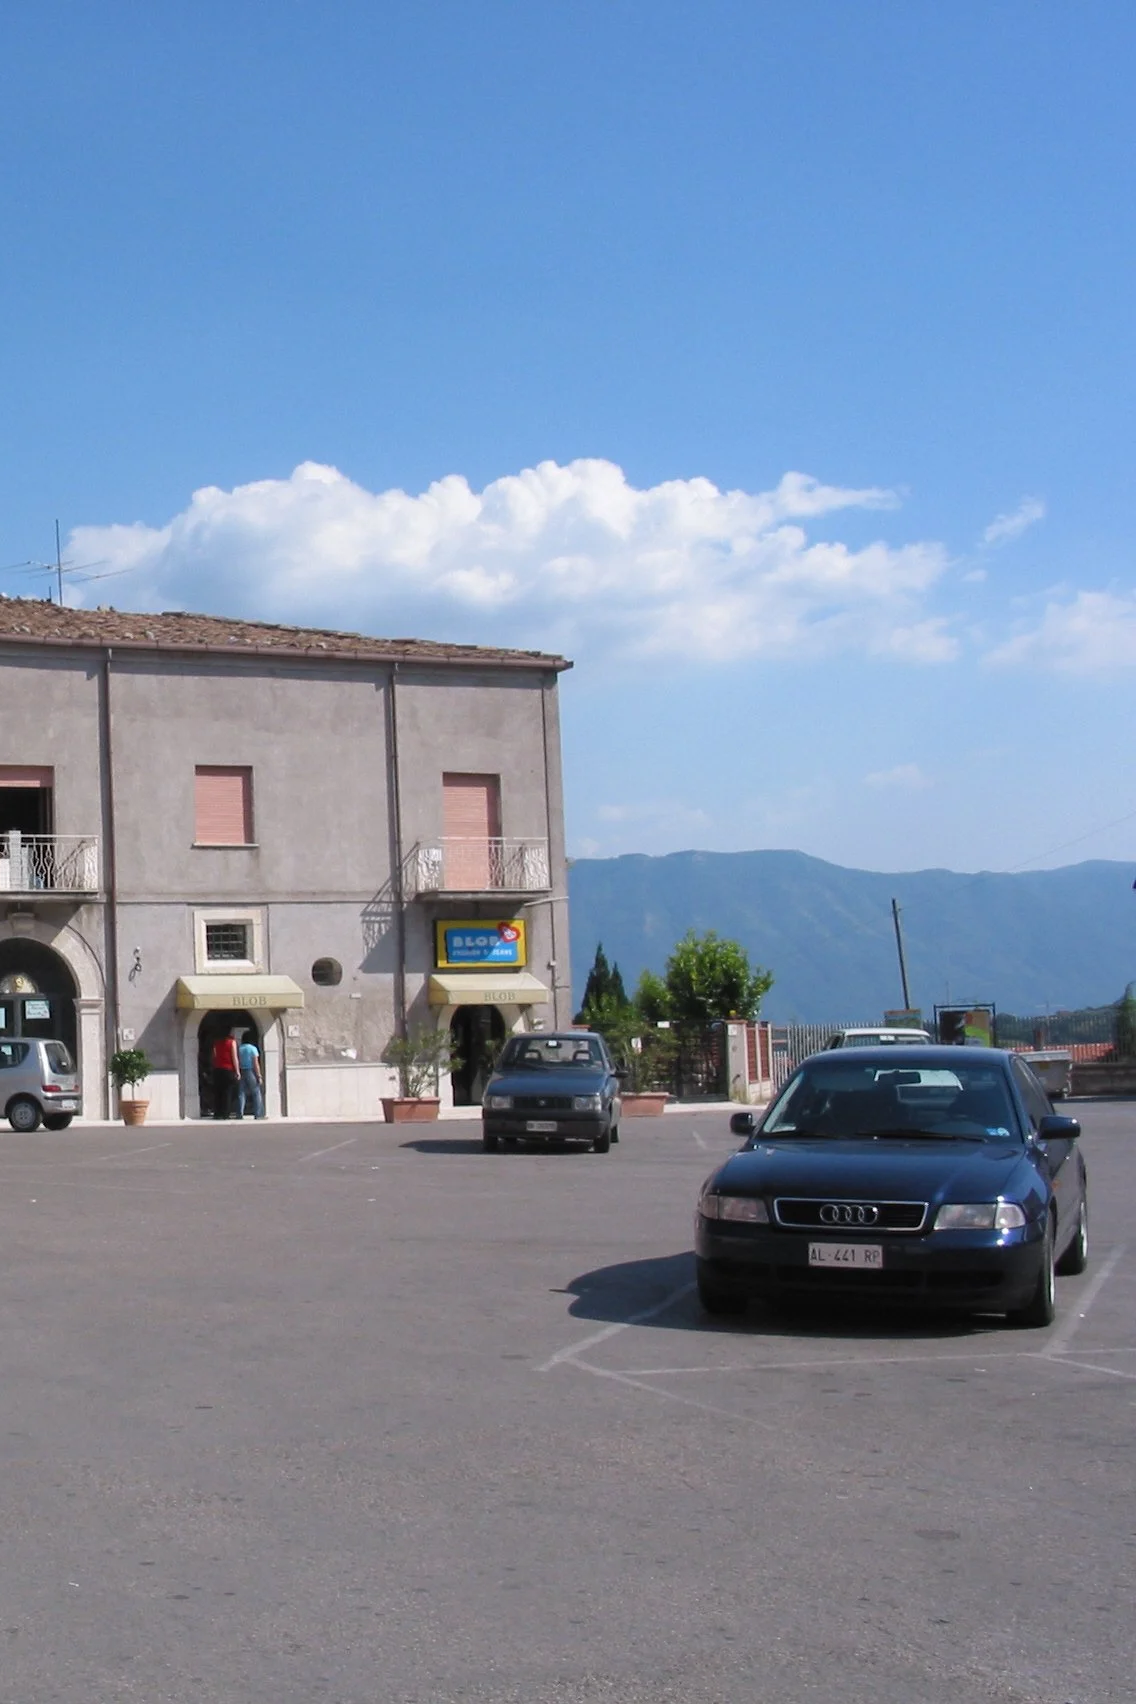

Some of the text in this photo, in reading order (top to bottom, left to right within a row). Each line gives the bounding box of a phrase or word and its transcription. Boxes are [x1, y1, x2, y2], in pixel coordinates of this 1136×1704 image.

[452, 936, 500, 948] BLOB
[232, 996, 267, 1007] BLOB
[485, 992, 515, 1002] BLOB
[834, 1249, 855, 1261] 441
